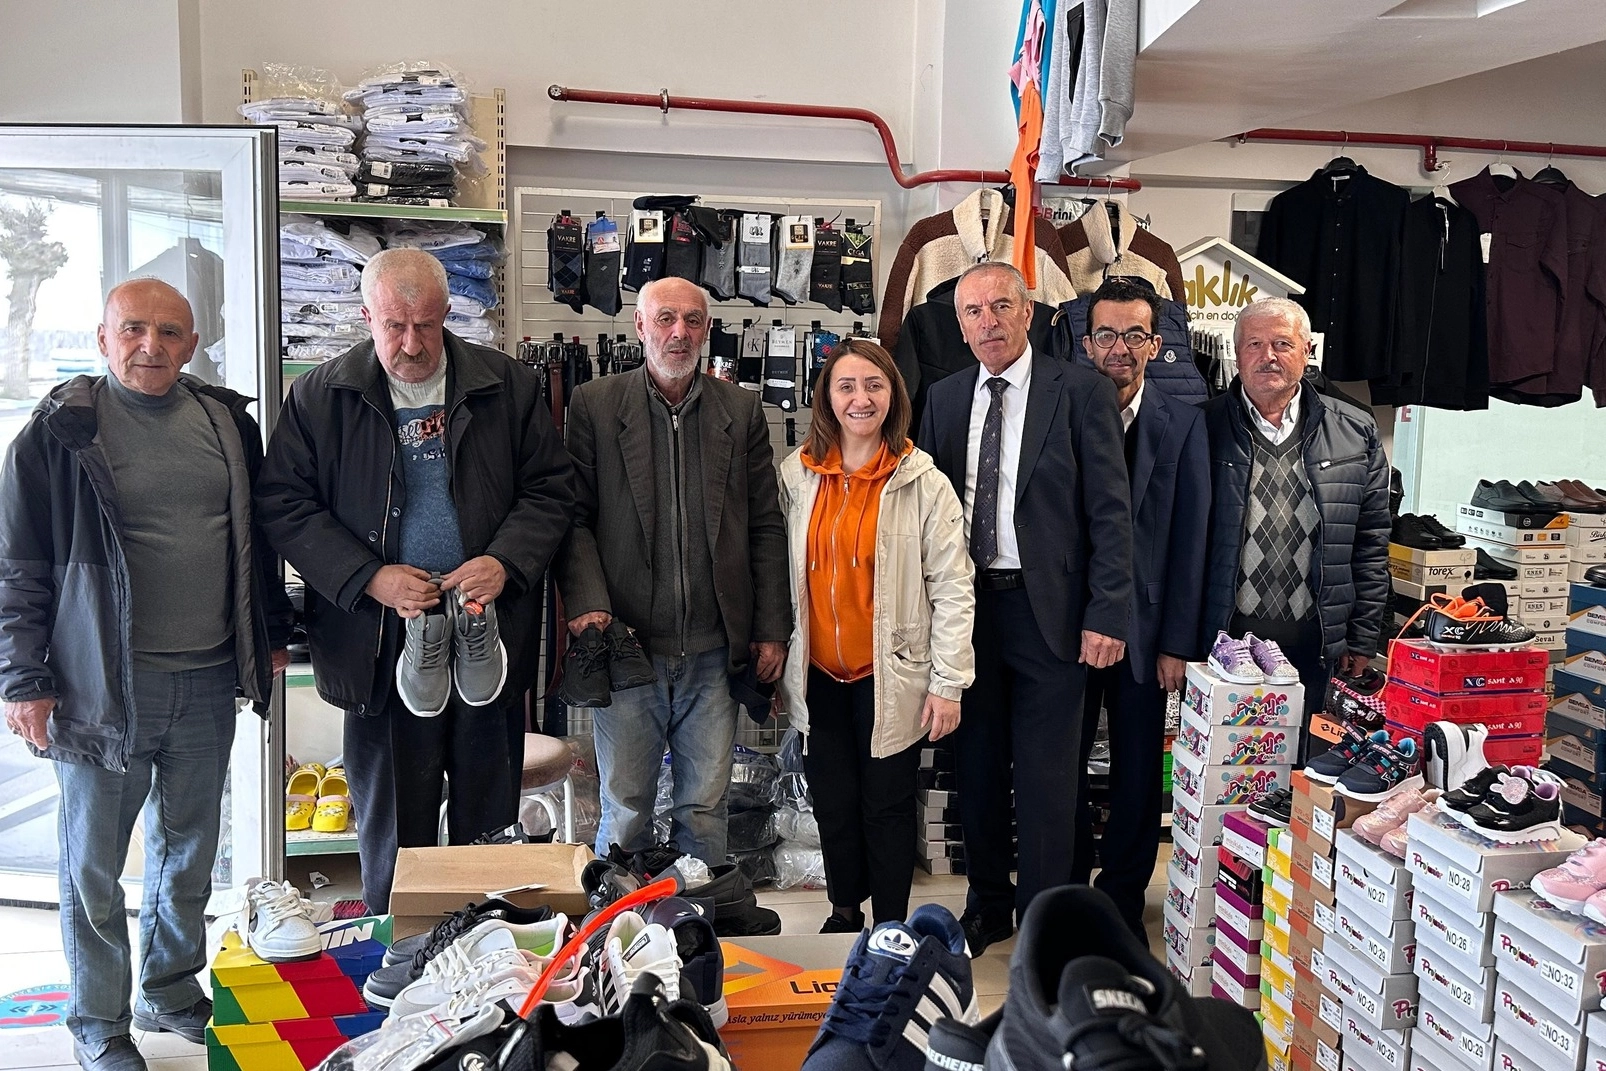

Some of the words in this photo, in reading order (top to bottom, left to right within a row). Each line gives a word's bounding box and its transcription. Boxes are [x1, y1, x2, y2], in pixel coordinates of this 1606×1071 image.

[557, 234, 576, 243] VAKRE
[1206, 312, 1219, 320] en
[1449, 870, 1471, 892] NO:28
[1367, 887, 1385, 903] NO:27
[1368, 941, 1386, 962] NO:29
[1446, 931, 1467, 951] NO:26
[1548, 965, 1574, 990] NO:32
[1356, 992, 1375, 1014] NO:29
[1450, 983, 1472, 1005] NO:28
[747, 1012, 779, 1025] yalnız
[1462, 1036, 1484, 1058] NO:29
[1545, 1024, 1569, 1051] NO:33
[1376, 1040, 1395, 1063] NO:26
